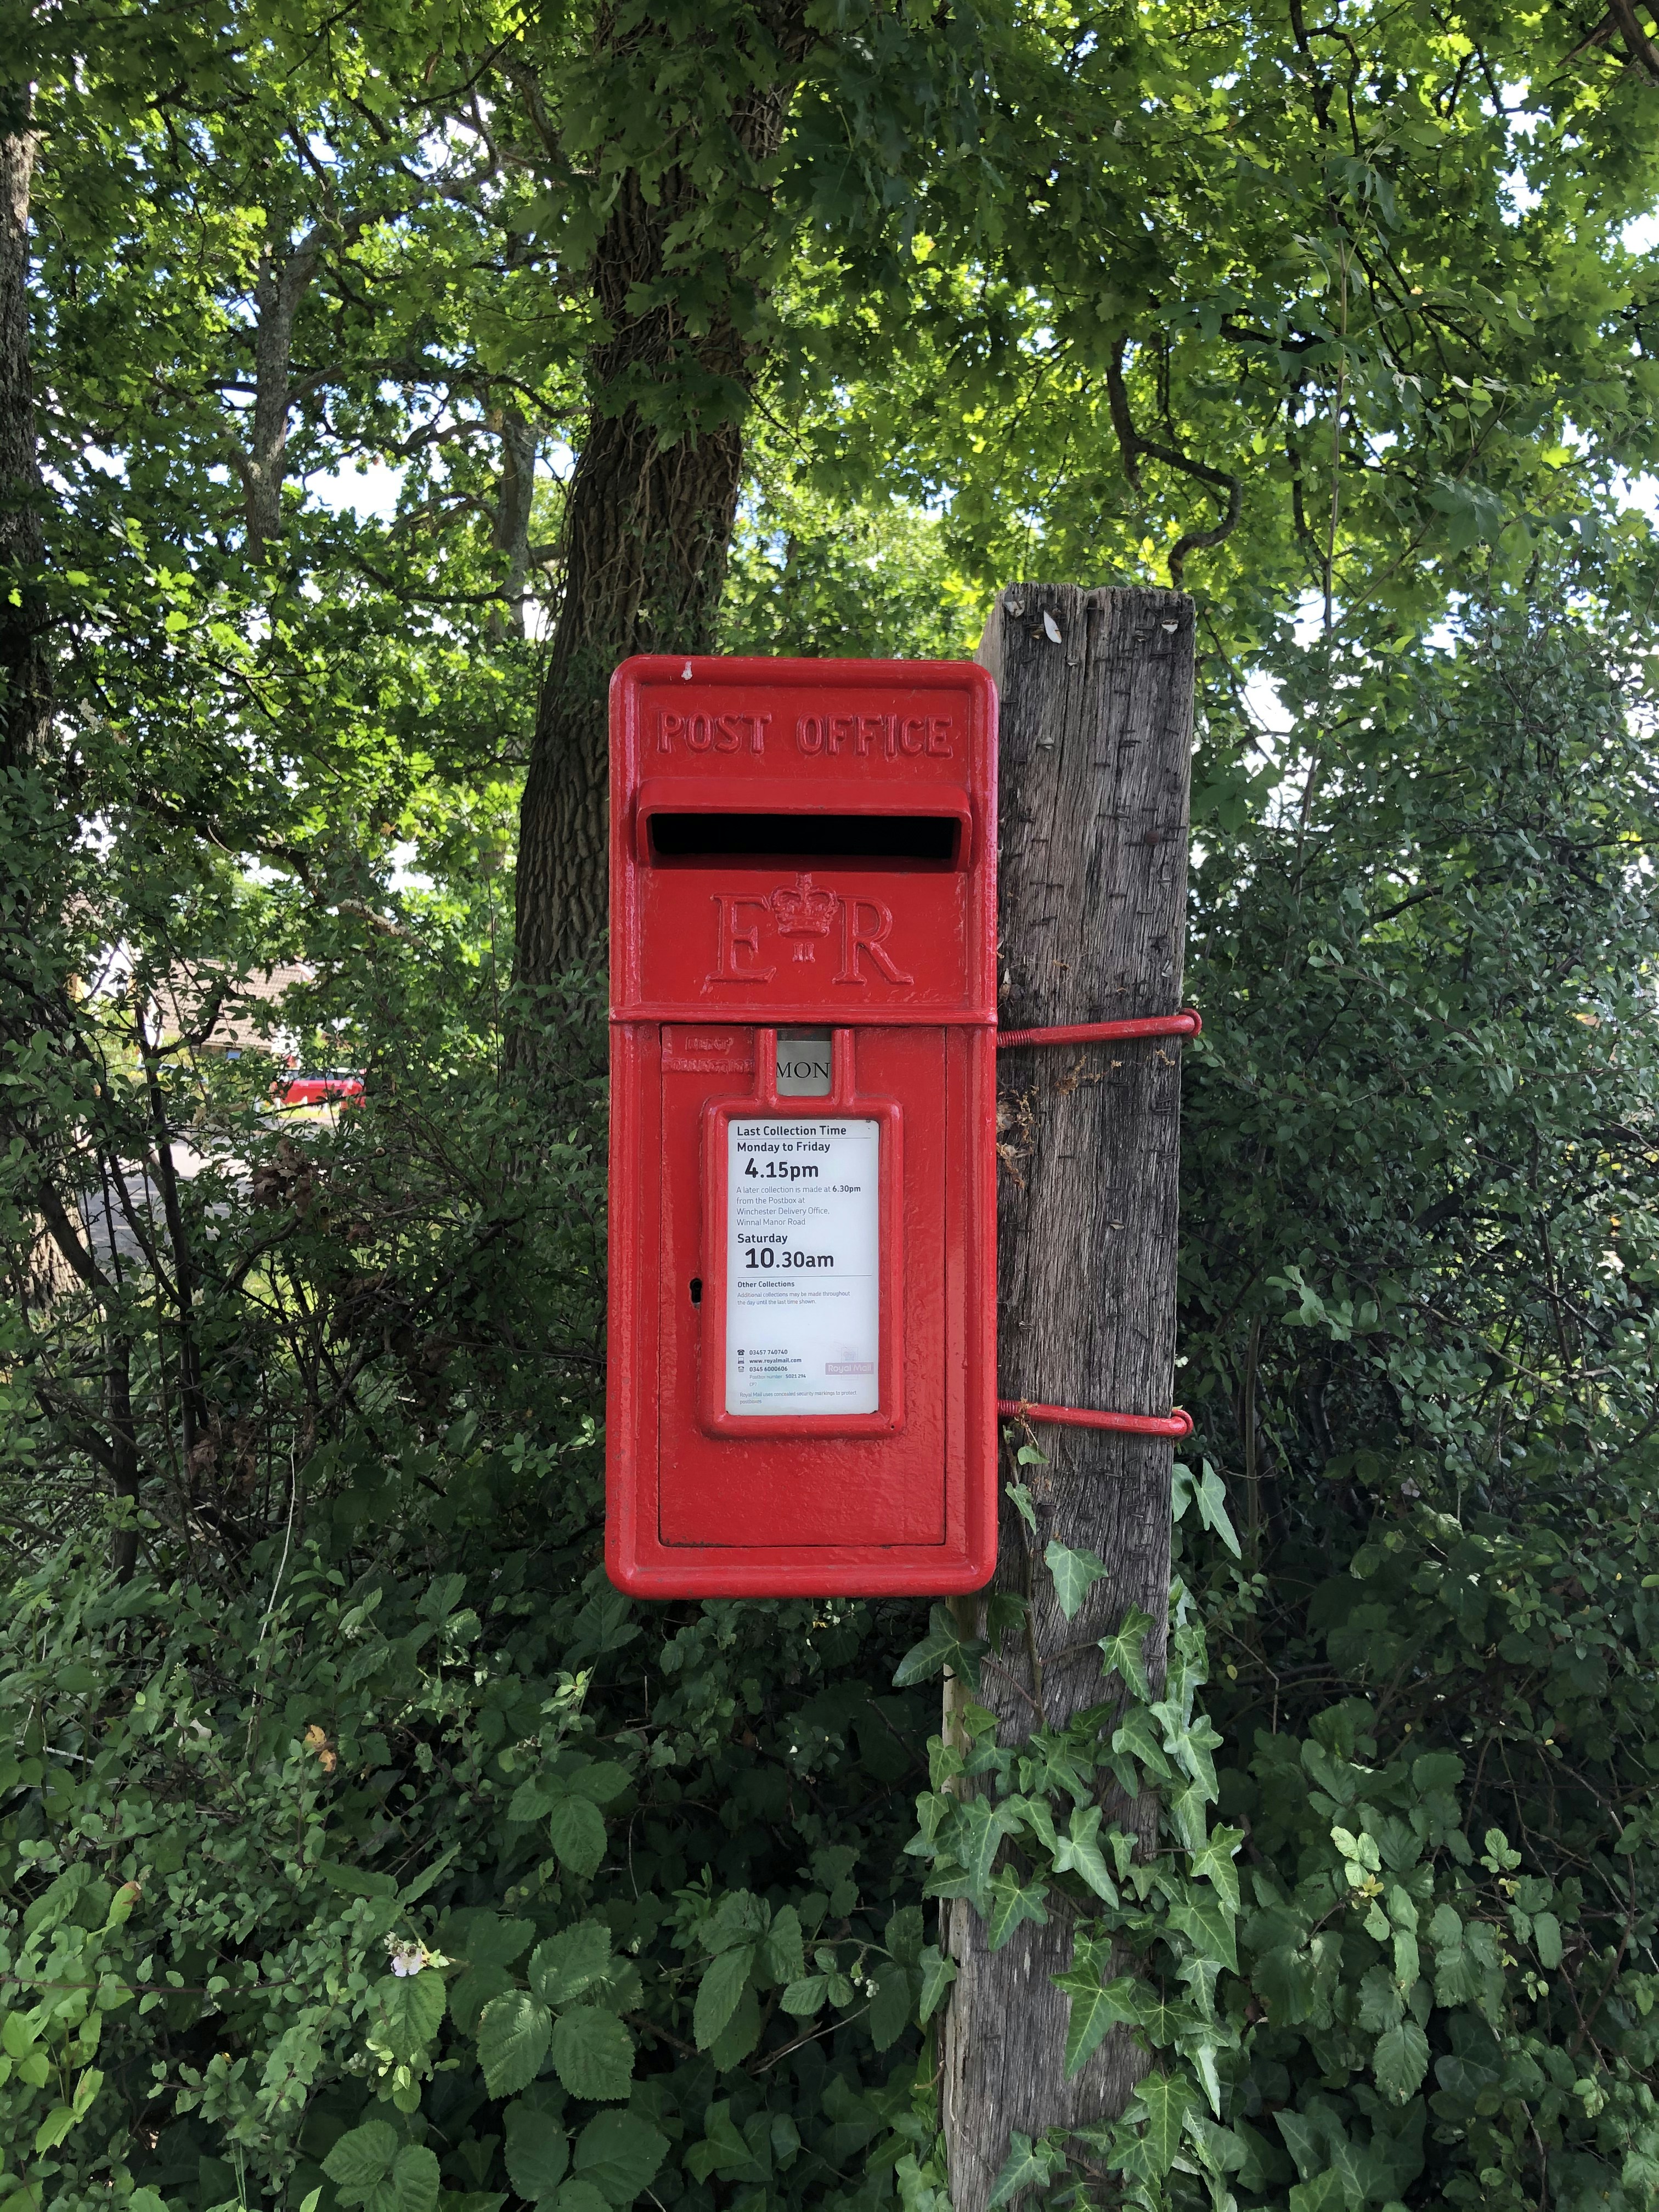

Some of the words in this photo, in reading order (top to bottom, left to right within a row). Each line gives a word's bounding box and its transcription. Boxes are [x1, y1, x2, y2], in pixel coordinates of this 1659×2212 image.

[657, 711, 771, 754] POST
[796, 713, 953, 759] OFFICE
[706, 893, 776, 984] E
[832, 894, 914, 986] R
[776, 1062, 831, 1079] MON
[737, 1126, 760, 1136] Last
[764, 1126, 816, 1136] Collection
[819, 1125, 847, 1135] Time
[737, 1142, 780, 1154] Monday
[782, 1143, 793, 1152] to
[797, 1142, 830, 1153] Friday
[745, 1158, 819, 1181] 4.15pm
[832, 1185, 861, 1193] 6.30pm
[778, 1207, 806, 1216] Delivery
[737, 1233, 788, 1245] Saturday
[746, 1248, 834, 1268] 10.30am
[828, 1364, 851, 1373] Royal
